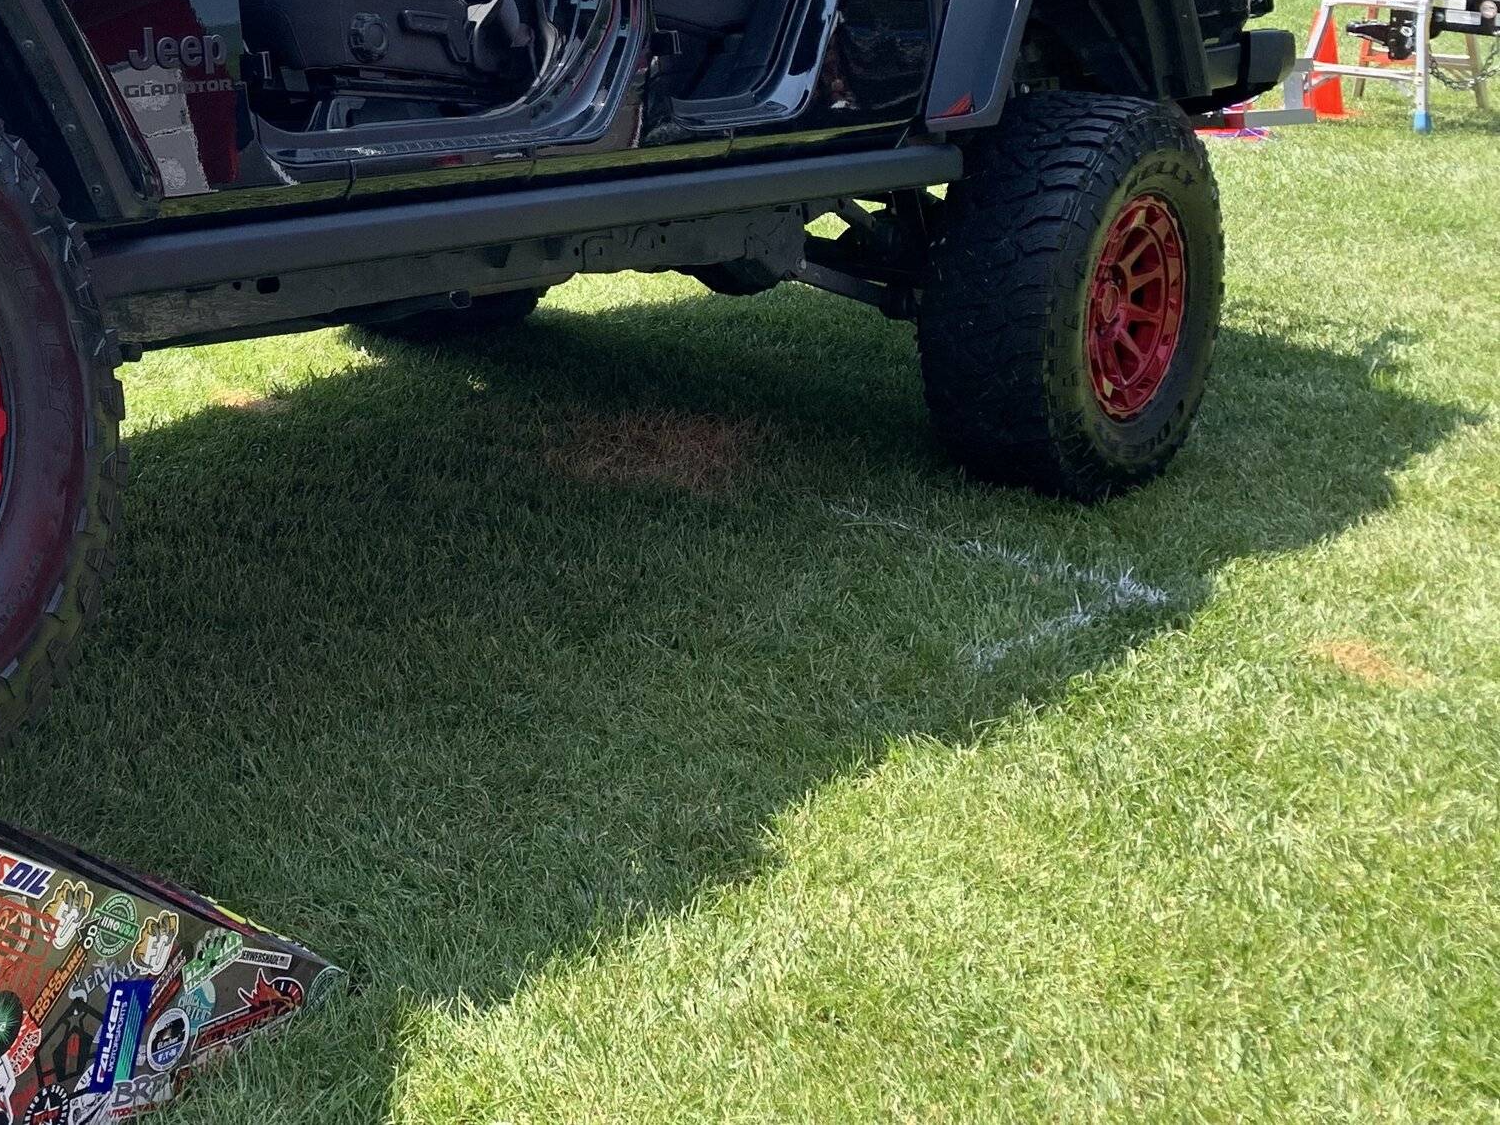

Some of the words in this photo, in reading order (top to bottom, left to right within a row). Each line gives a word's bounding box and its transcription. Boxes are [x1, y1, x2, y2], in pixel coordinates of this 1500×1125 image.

[128, 27, 227, 73] Jeep
[123, 78, 236, 98] GLADIATOR
[97, 989, 124, 1084] FALKEN
[108, 1001, 128, 1073] MOTORSPORTS
